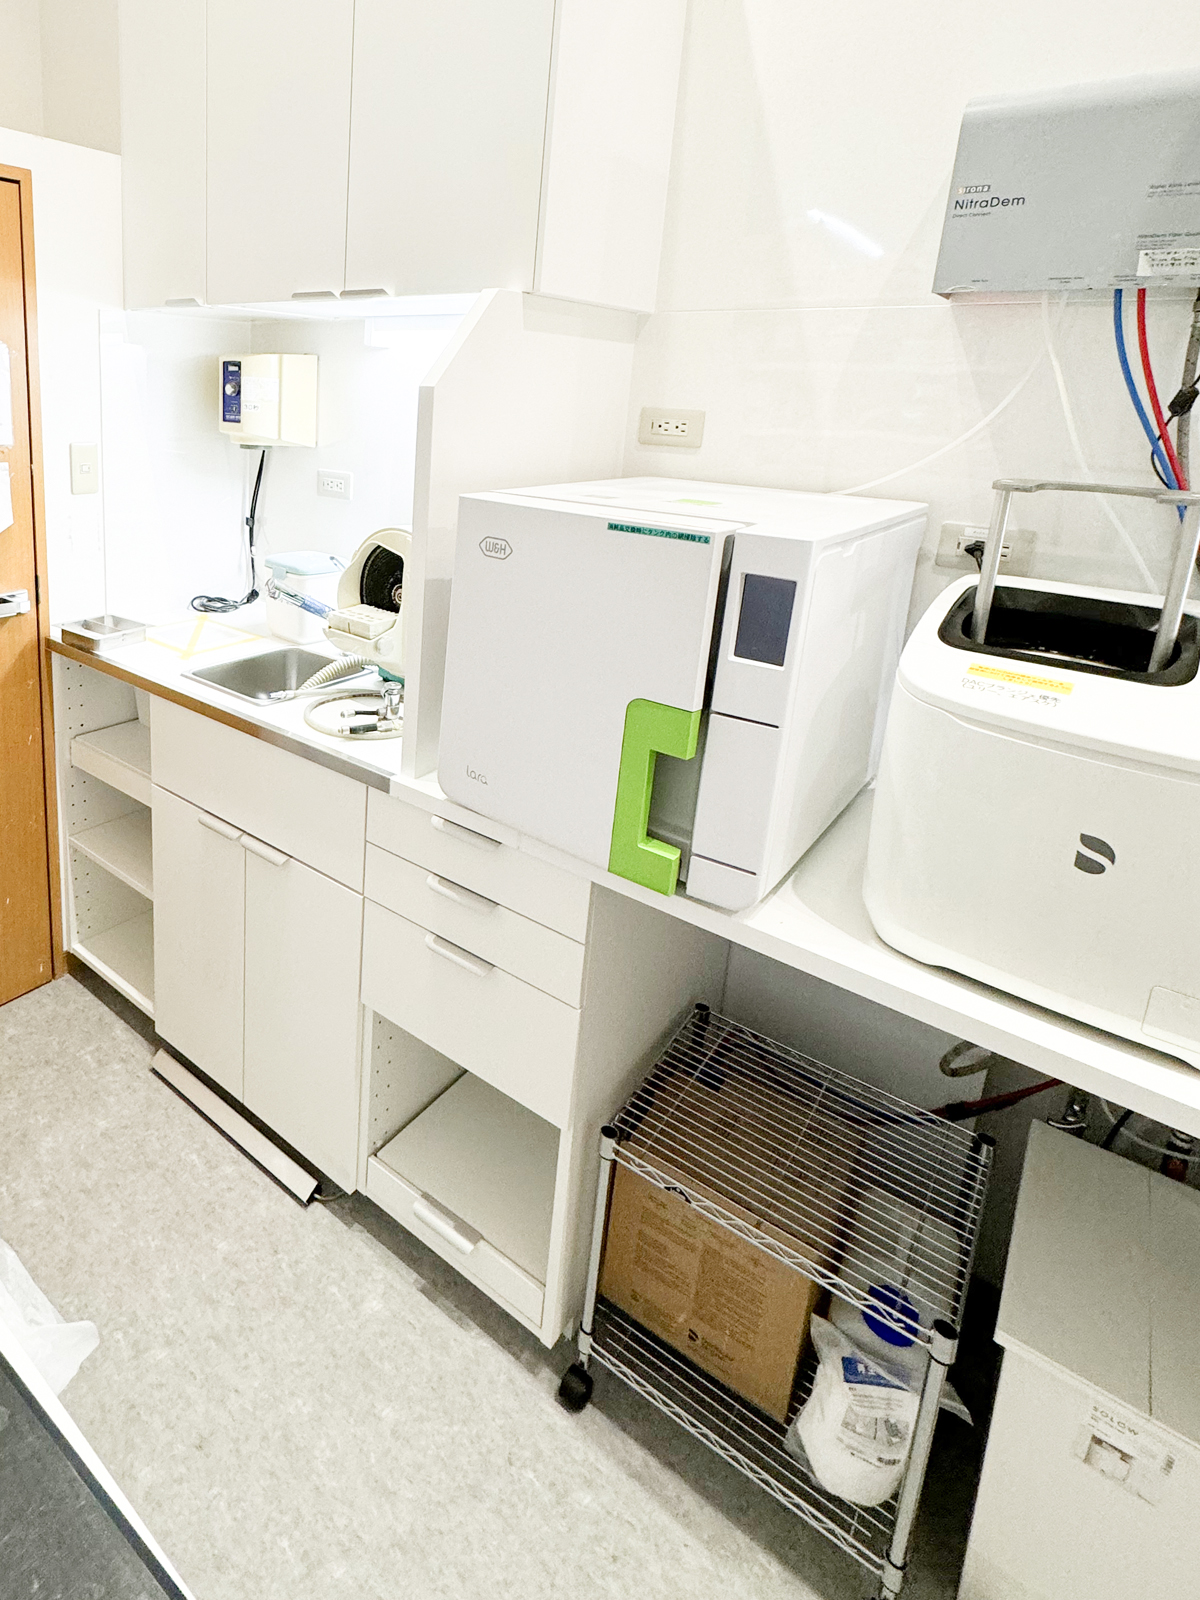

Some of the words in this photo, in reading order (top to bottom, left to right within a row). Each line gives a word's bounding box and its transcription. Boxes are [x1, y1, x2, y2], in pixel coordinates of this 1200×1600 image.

[957, 184, 991, 195] sirona
[954, 196, 1026, 210] NitraDem
[485, 540, 507, 556] W&H
